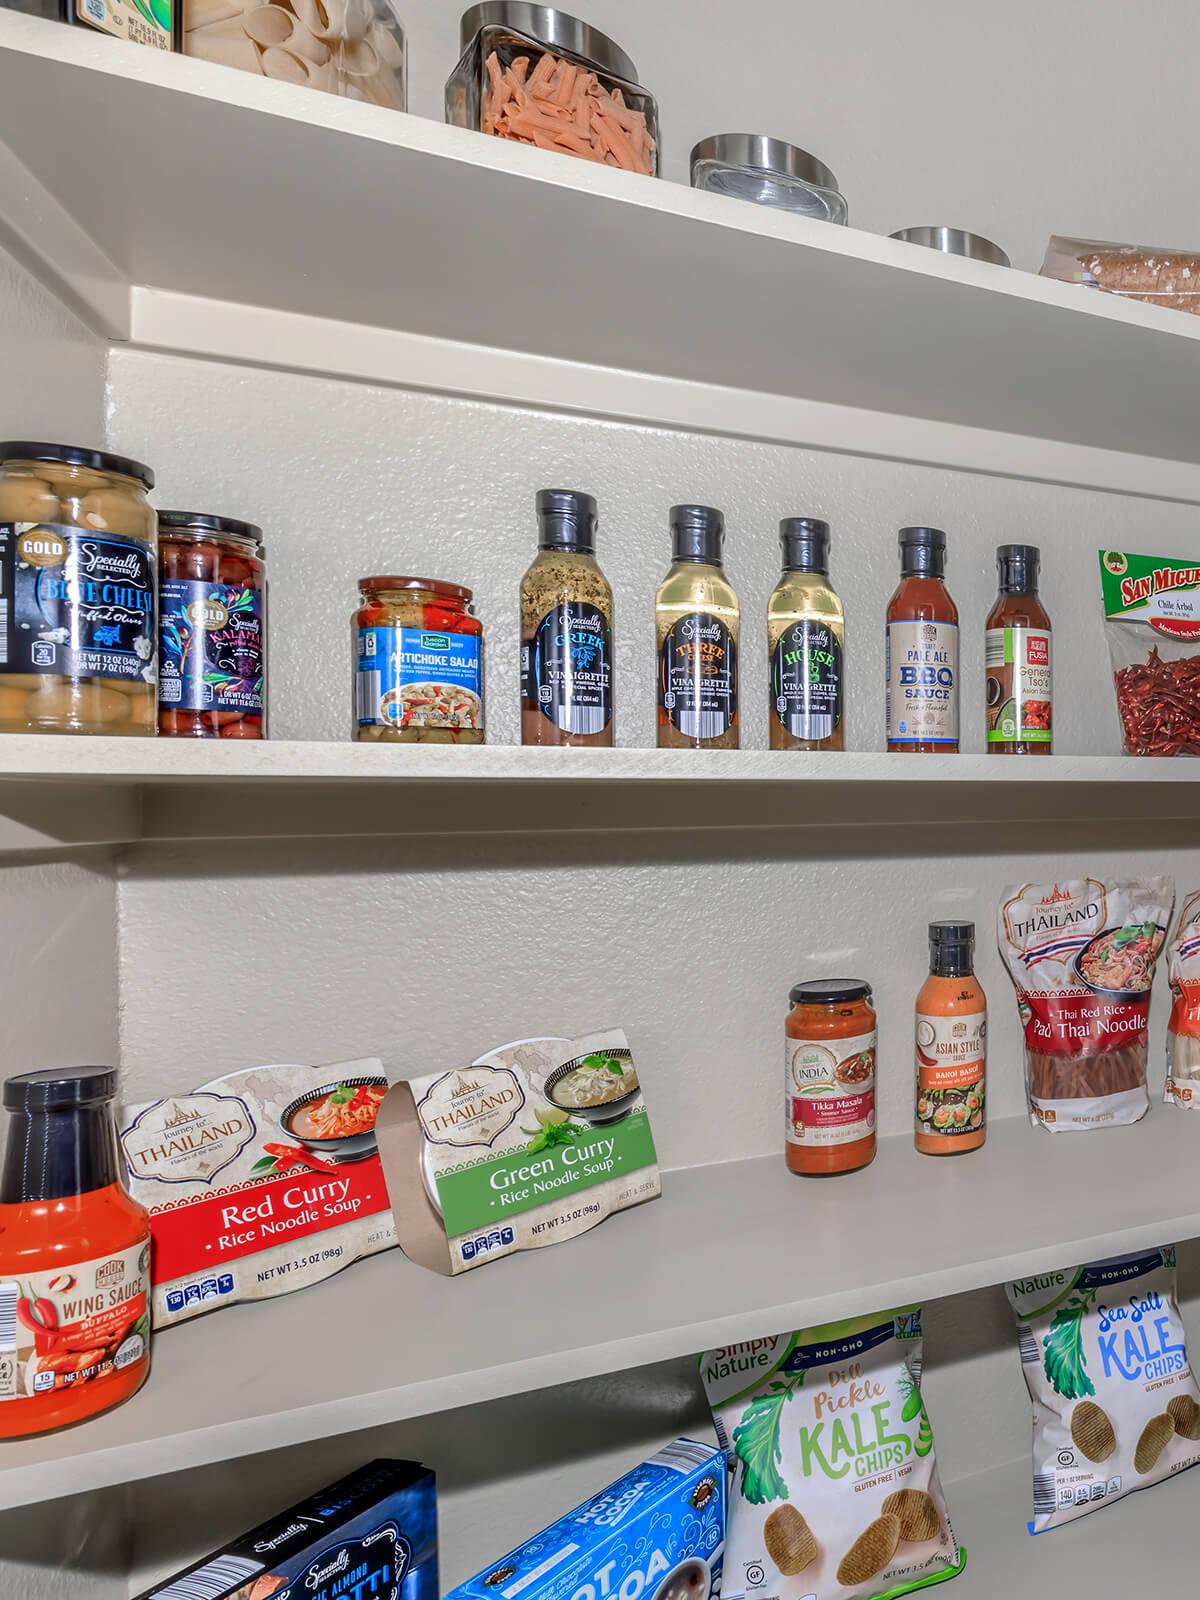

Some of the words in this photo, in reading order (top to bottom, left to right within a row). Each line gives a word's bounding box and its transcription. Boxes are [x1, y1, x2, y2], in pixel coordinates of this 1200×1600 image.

[23, 540, 63, 555] GOLD
[78, 543, 142, 578] Specially
[96, 564, 132, 575] SELECTED
[1121, 577, 1151, 606] SAN
[1157, 599, 1175, 611] Chile
[554, 632, 606, 650] GREEK
[681, 619, 721, 642] Specially
[390, 651, 448, 667] ARTICHOKE
[449, 658, 479, 669] SALAD
[675, 641, 726, 660] THREE
[784, 649, 836, 668] HOUSE
[907, 650, 930, 662] PALE
[933, 651, 949, 663] ALE
[1029, 651, 1049, 661] FUSIA
[900, 665, 954, 690] BBQ
[1028, 678, 1049, 688] Tso's
[904, 688, 950, 700] SAUCE
[1014, 903, 1100, 938] THAILAND
[1056, 1008, 1078, 1020] Thai
[1080, 1006, 1101, 1018] Red
[1103, 1004, 1126, 1016] Rice
[1033, 1021, 1052, 1039] Pad
[1057, 1021, 1091, 1039] Thai
[1096, 1015, 1147, 1034] Noodle
[935, 1042, 959, 1055] ASIAN
[960, 1039, 980, 1052] STYLE
[799, 1066, 829, 1080] INDIA
[429, 1088, 514, 1132] THAILAND
[811, 1101, 834, 1111] Tikka
[836, 1097, 863, 1109] Masala
[134, 1119, 243, 1166] THAILAND
[163, 1126, 194, 1141] Journey
[489, 1157, 555, 1192] Green
[560, 1136, 616, 1167] Curry
[499, 1187, 531, 1208] Rice
[532, 1169, 581, 1196] Noodle
[583, 1159, 615, 1178] Soup
[220, 1194, 274, 1230] Red
[282, 1177, 352, 1210] Curry
[217, 1228, 256, 1251] Rice
[260, 1207, 320, 1238] Noodle
[323, 1196, 362, 1218] Soup
[531, 1223, 546, 1236] NET
[546, 1218, 559, 1230] WT
[560, 1214, 572, 1225] 3.5
[572, 1209, 583, 1219] OZ
[582, 1201, 601, 1216] (98g)
[96, 1260, 125, 1278] COOK
[257, 1266, 275, 1283] NET
[276, 1263, 292, 1277] WT
[293, 1258, 308, 1271] 3.5
[308, 1254, 321, 1264] OZ
[321, 1245, 344, 1261] (98g)
[1101, 1265, 1140, 1280] NON-GMO
[1012, 1269, 1065, 1298] Nature
[63, 1294, 104, 1320] WING
[109, 1277, 143, 1306] SAUCE
[80, 1305, 128, 1330] BUFFALO
[1097, 1304, 1129, 1333] Sea
[1130, 1291, 1164, 1323] Salt
[815, 1339, 863, 1359] NON-GMO
[1096, 1316, 1187, 1382] KALE
[40, 1373, 50, 1382] 15
[64, 1372, 81, 1384] NET
[80, 1366, 96, 1379] WT
[707, 1350, 770, 1384] Nature
[828, 1362, 864, 1388] Dill
[1144, 1353, 1184, 1380] CHIPS
[1145, 1380, 1163, 1393] GLUTEN
[1162, 1377, 1175, 1388] FREE
[812, 1379, 887, 1420] Pickle
[799, 1400, 912, 1480] KALE
[854, 1444, 903, 1478] CHIPS
[853, 1478, 878, 1493] GLUTEN
[878, 1473, 894, 1487] FREE
[897, 1465, 913, 1479] VEGAN
[593, 1481, 650, 1526] COCOA
[1060, 1489, 1072, 1500] 140
[575, 1495, 613, 1525] HOT
[254, 1521, 308, 1553] Specially
[708, 1530, 718, 1546] 10
[304, 1548, 351, 1590] Specially
[331, 1561, 368, 1597] ALMOND
[750, 1569, 761, 1579] GF
[883, 1569, 897, 1581] NET
[898, 1566, 912, 1577] WT
